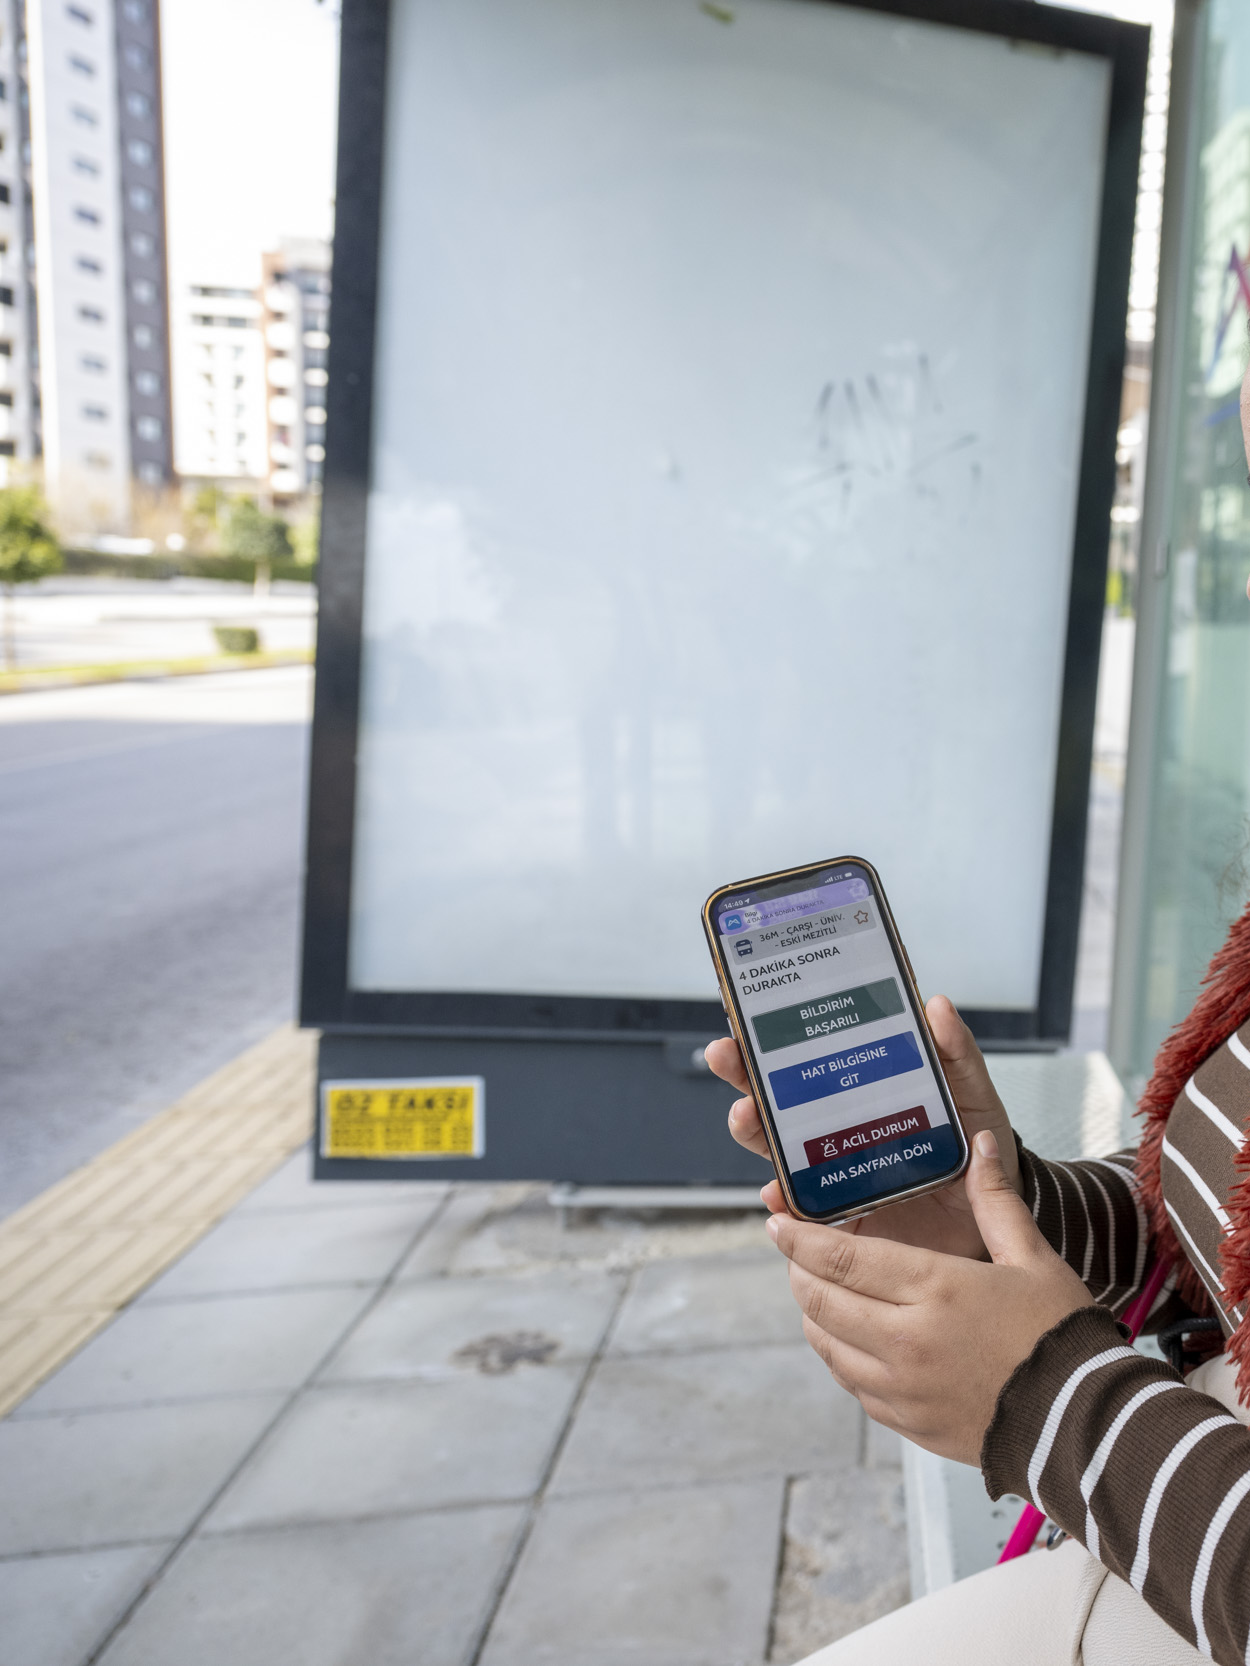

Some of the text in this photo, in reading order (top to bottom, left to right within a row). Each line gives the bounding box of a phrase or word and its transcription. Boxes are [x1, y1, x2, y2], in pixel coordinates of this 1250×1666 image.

[774, 907, 796, 916] SONRA
[796, 900, 824, 911] DURAKTA
[760, 930, 779, 942] 36M
[786, 921, 814, 936] ÇARŞI
[820, 914, 846, 926] ÜNİV.
[780, 934, 802, 948] ESKİ
[802, 926, 837, 941] MEZİTLİ
[739, 946, 840, 980] 4 DAKİKA SONRA
[742, 972, 802, 995] DURAKTA
[800, 996, 855, 1020] BİLDİRİM
[805, 1012, 860, 1036] BAŞARILI
[801, 1046, 888, 1080] HAT BİLGİSİNE
[840, 1073, 860, 1088] GİT
[842, 1116, 920, 1150] ACİL DURUM
[820, 1142, 933, 1188] ANA SAYFAYA DÖN
